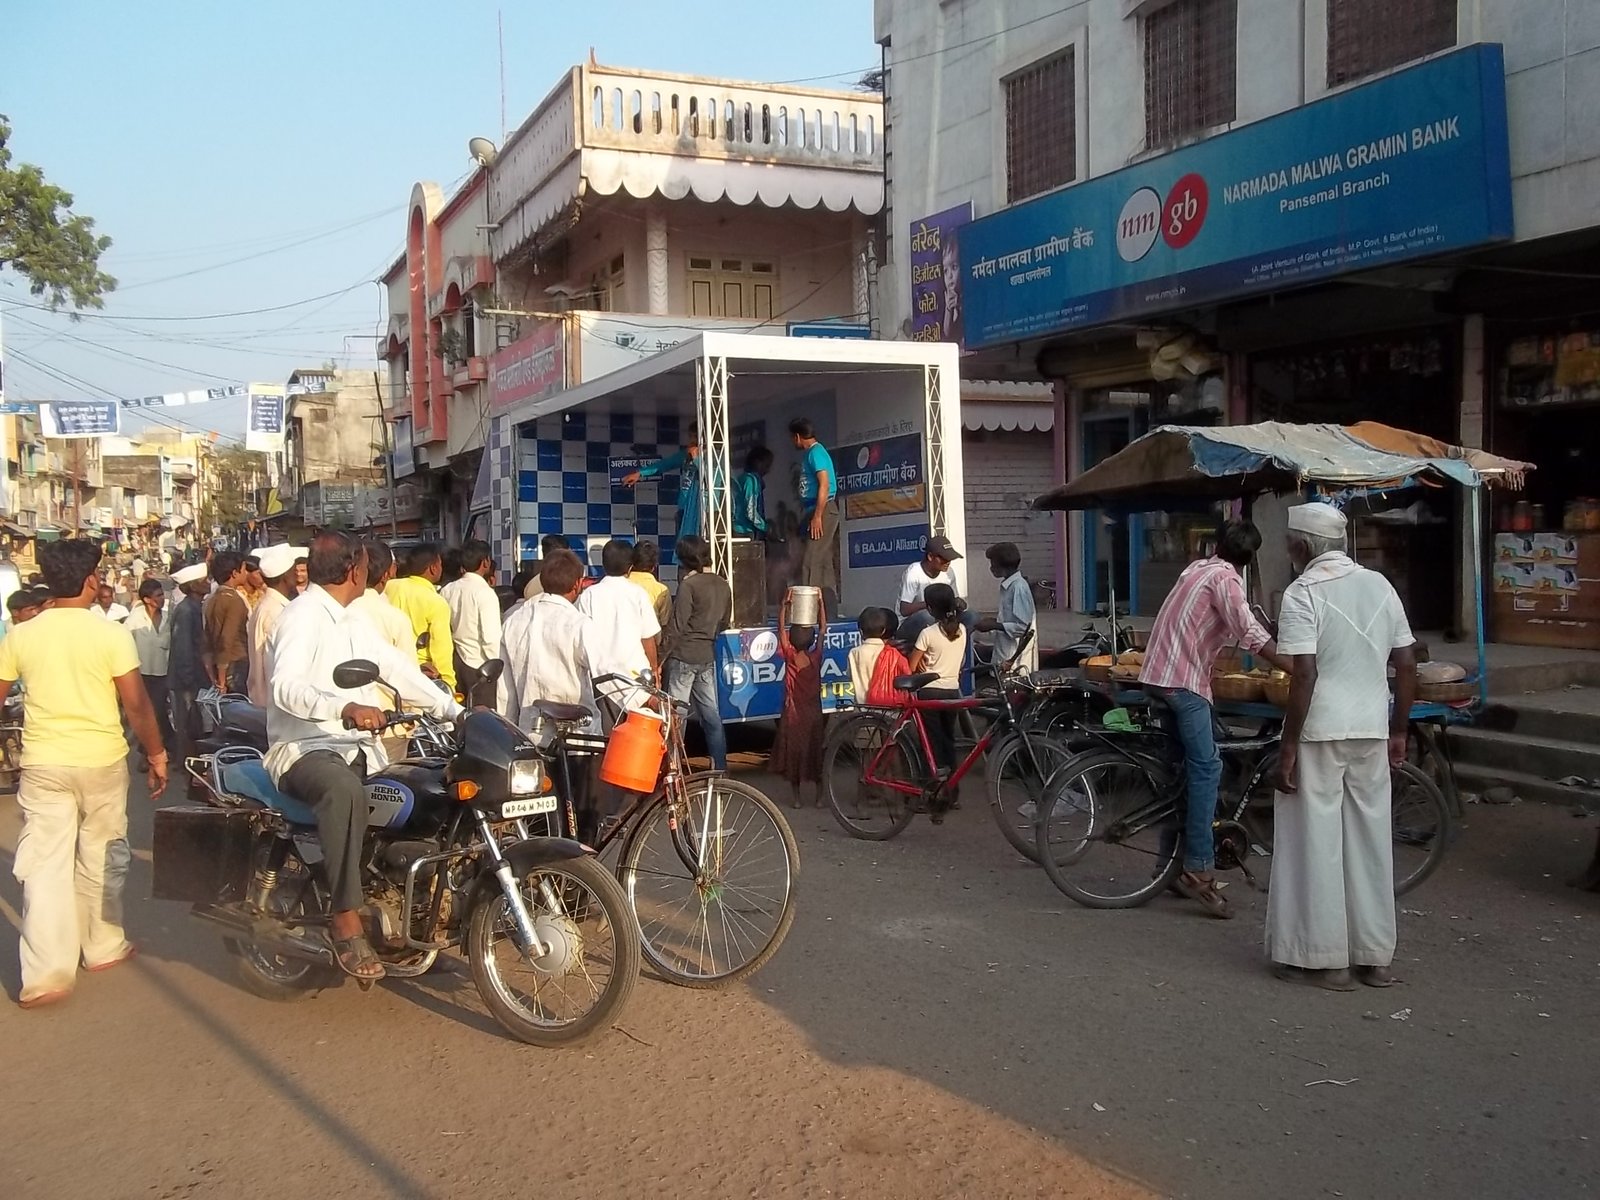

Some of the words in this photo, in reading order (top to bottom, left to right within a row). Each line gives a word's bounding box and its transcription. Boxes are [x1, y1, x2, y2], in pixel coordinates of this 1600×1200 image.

[1223, 170, 1288, 205] NARMADA
[1291, 153, 1343, 185] MALWA
[1346, 131, 1408, 169] GRAMIN
[1411, 116, 1460, 150] BANK
[1279, 183, 1339, 213] Pansemal
[1342, 171, 1390, 196] Branch
[1122, 211, 1155, 239] nm
[1169, 189, 1198, 235] gb
[912, 223, 941, 253] नरेन्द्र
[971, 256, 996, 279] नर्मदा
[998, 248, 1032, 272] मालवा
[1034, 235, 1070, 263] ग्रामीण
[1072, 226, 1095, 249] बैंक
[848, 471, 872, 489] मालवा
[873, 463, 899, 485] ग्रामीण
[900, 460, 917, 481] बैंक
[862, 540, 893, 554] BAJAJ
[895, 538, 919, 552] Allianz
[371, 792, 404, 803] HONDA
[374, 786, 400, 795] HERO
